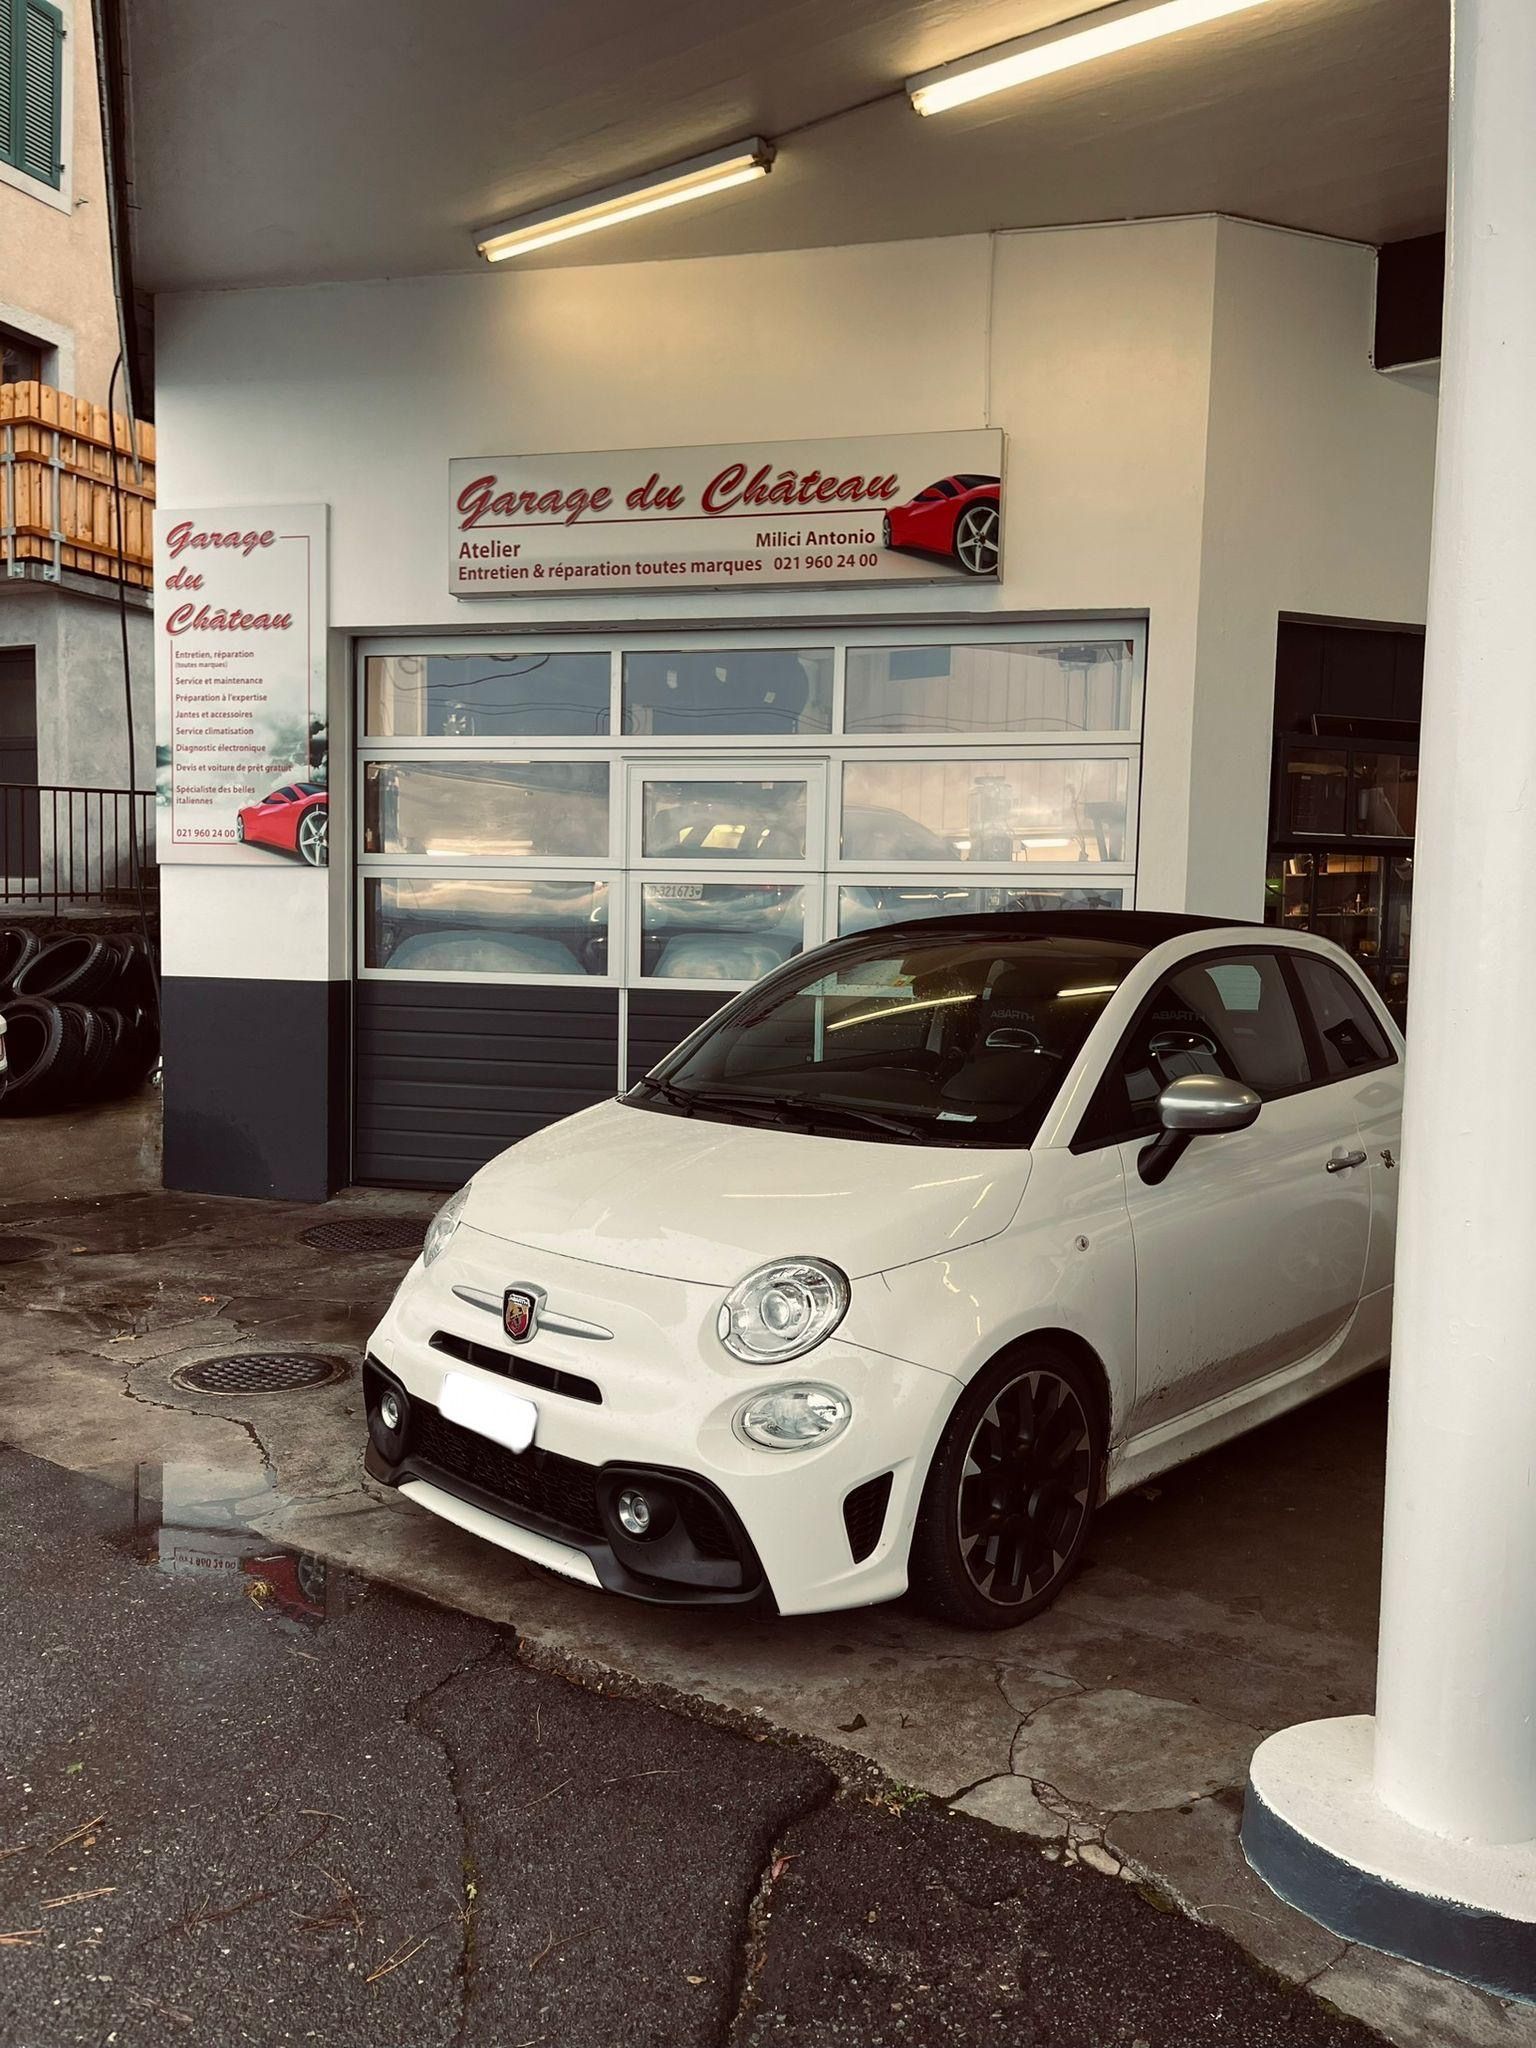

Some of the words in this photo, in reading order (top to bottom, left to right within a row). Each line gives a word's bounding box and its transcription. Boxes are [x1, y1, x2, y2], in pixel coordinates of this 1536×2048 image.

[456, 474, 613, 532] Garage
[625, 473, 685, 511] du
[701, 463, 899, 514] Château
[166, 521, 276, 559] Garage
[756, 531, 801, 547] Milici
[805, 529, 875, 546] Antonio
[459, 540, 521, 559] Atelier
[458, 565, 529, 580] Entretien
[533, 563, 544, 578] &
[548, 562, 631, 581] réparation
[635, 560, 686, 575] toutes
[690, 559, 762, 576] marques
[774, 556, 799, 571] 021
[805, 555, 833, 569] 960
[836, 554, 855, 568] 24
[859, 553, 878, 567] 00
[165, 566, 204, 590] du
[165, 603, 293, 636] Château
[175, 651, 212, 660] Entretien,
[214, 650, 254, 660] réparation
[175, 677, 203, 685] Service
[213, 677, 263, 685] maintenance
[175, 693, 220, 703] Préparation
[227, 693, 268, 703] l'expertise
[175, 710, 200, 718] Jantes
[210, 710, 253, 718] accessoires
[176, 727, 203, 735] Service
[204, 726, 254, 735] climatisation
[176, 743, 216, 753] Diagnostic
[217, 743, 266, 753] électronique
[176, 763, 197, 771] Devis
[207, 763, 235, 771] voiture
[236, 763, 245, 771] de
[265, 763, 292, 773] gratuit
[176, 785, 217, 794] Spécialiste
[217, 785, 231, 793] des
[233, 785, 255, 793] belles
[176, 796, 213, 804] italiennes
[176, 829, 192, 837] 021
[194, 829, 210, 837] 960
[212, 829, 223, 838] 24
[224, 830, 236, 838] 00
[990, 1009, 1034, 1022] ABARTH
